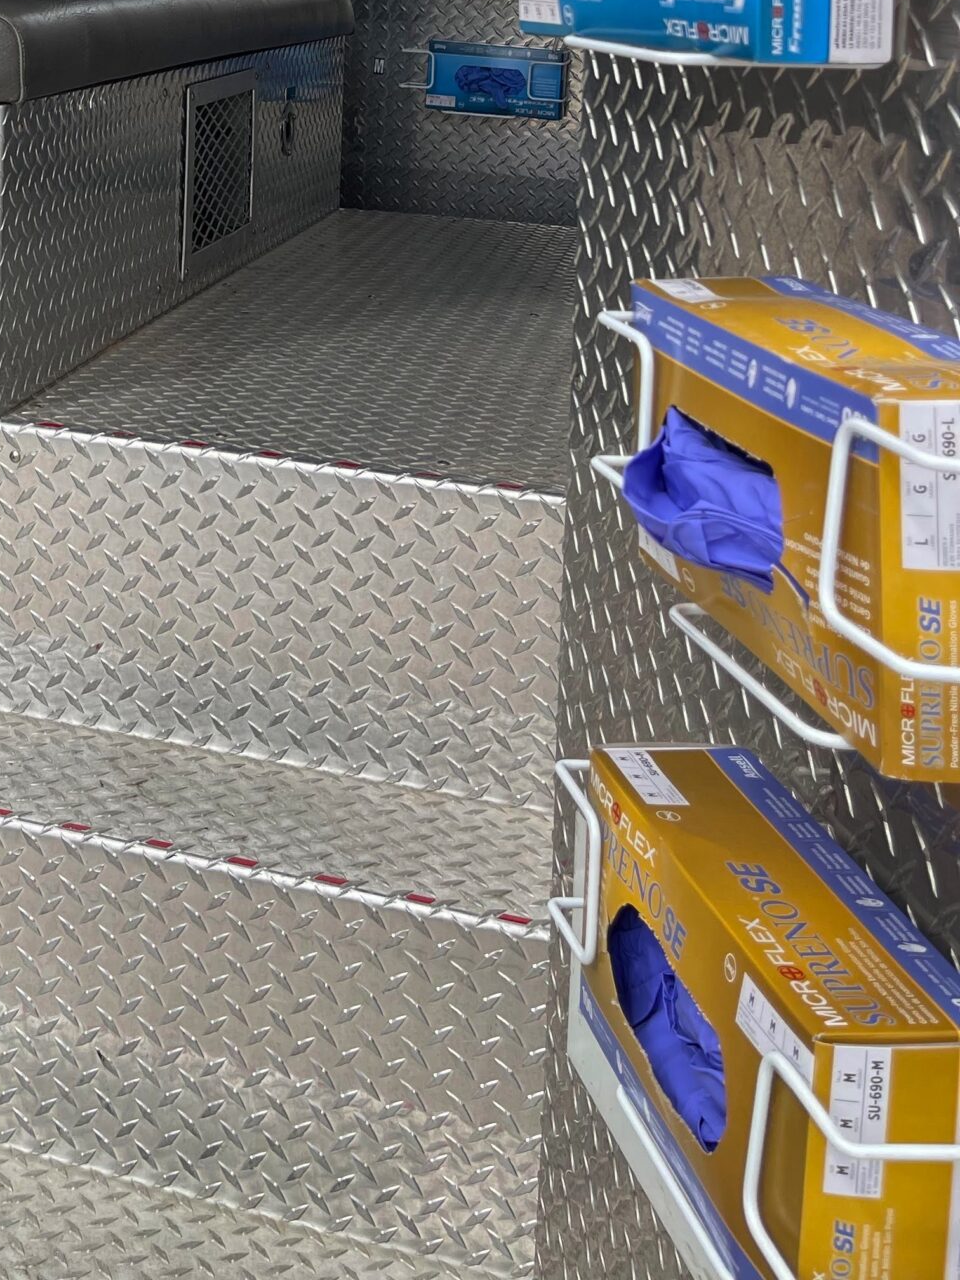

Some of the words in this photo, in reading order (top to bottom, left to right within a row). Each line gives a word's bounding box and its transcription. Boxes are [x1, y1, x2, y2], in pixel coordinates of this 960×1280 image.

[662, 17, 750, 46] MICROFLEX
[373, 58, 385, 74] M
[911, 433, 926, 443] G
[941, 417, 957, 481] S690-L
[912, 484, 928, 494] G
[913, 538, 929, 546] L
[919, 596, 942, 635] SE
[948, 599, 958, 629] Gloves
[772, 642, 877, 747] MICROFLEX
[919, 639, 944, 768] SUPREO
[949, 685, 959, 712] Nitrile
[950, 713, 960, 769] Powder-Free
[727, 754, 759, 779] Ansell
[590, 769, 656, 867] MICROFLEX
[600, 820, 664, 920] PRENO
[662, 905, 687, 961] SE
[727, 860, 782, 896] SE
[738, 914, 849, 1028] MICROFLEX
[757, 897, 896, 1027] SUPRENO
[843, 1072, 857, 1083] M
[867, 1060, 885, 1121] SU-690-M
[839, 1118, 854, 1129] M
[836, 1164, 850, 1176] M
[833, 1219, 854, 1254] SE
